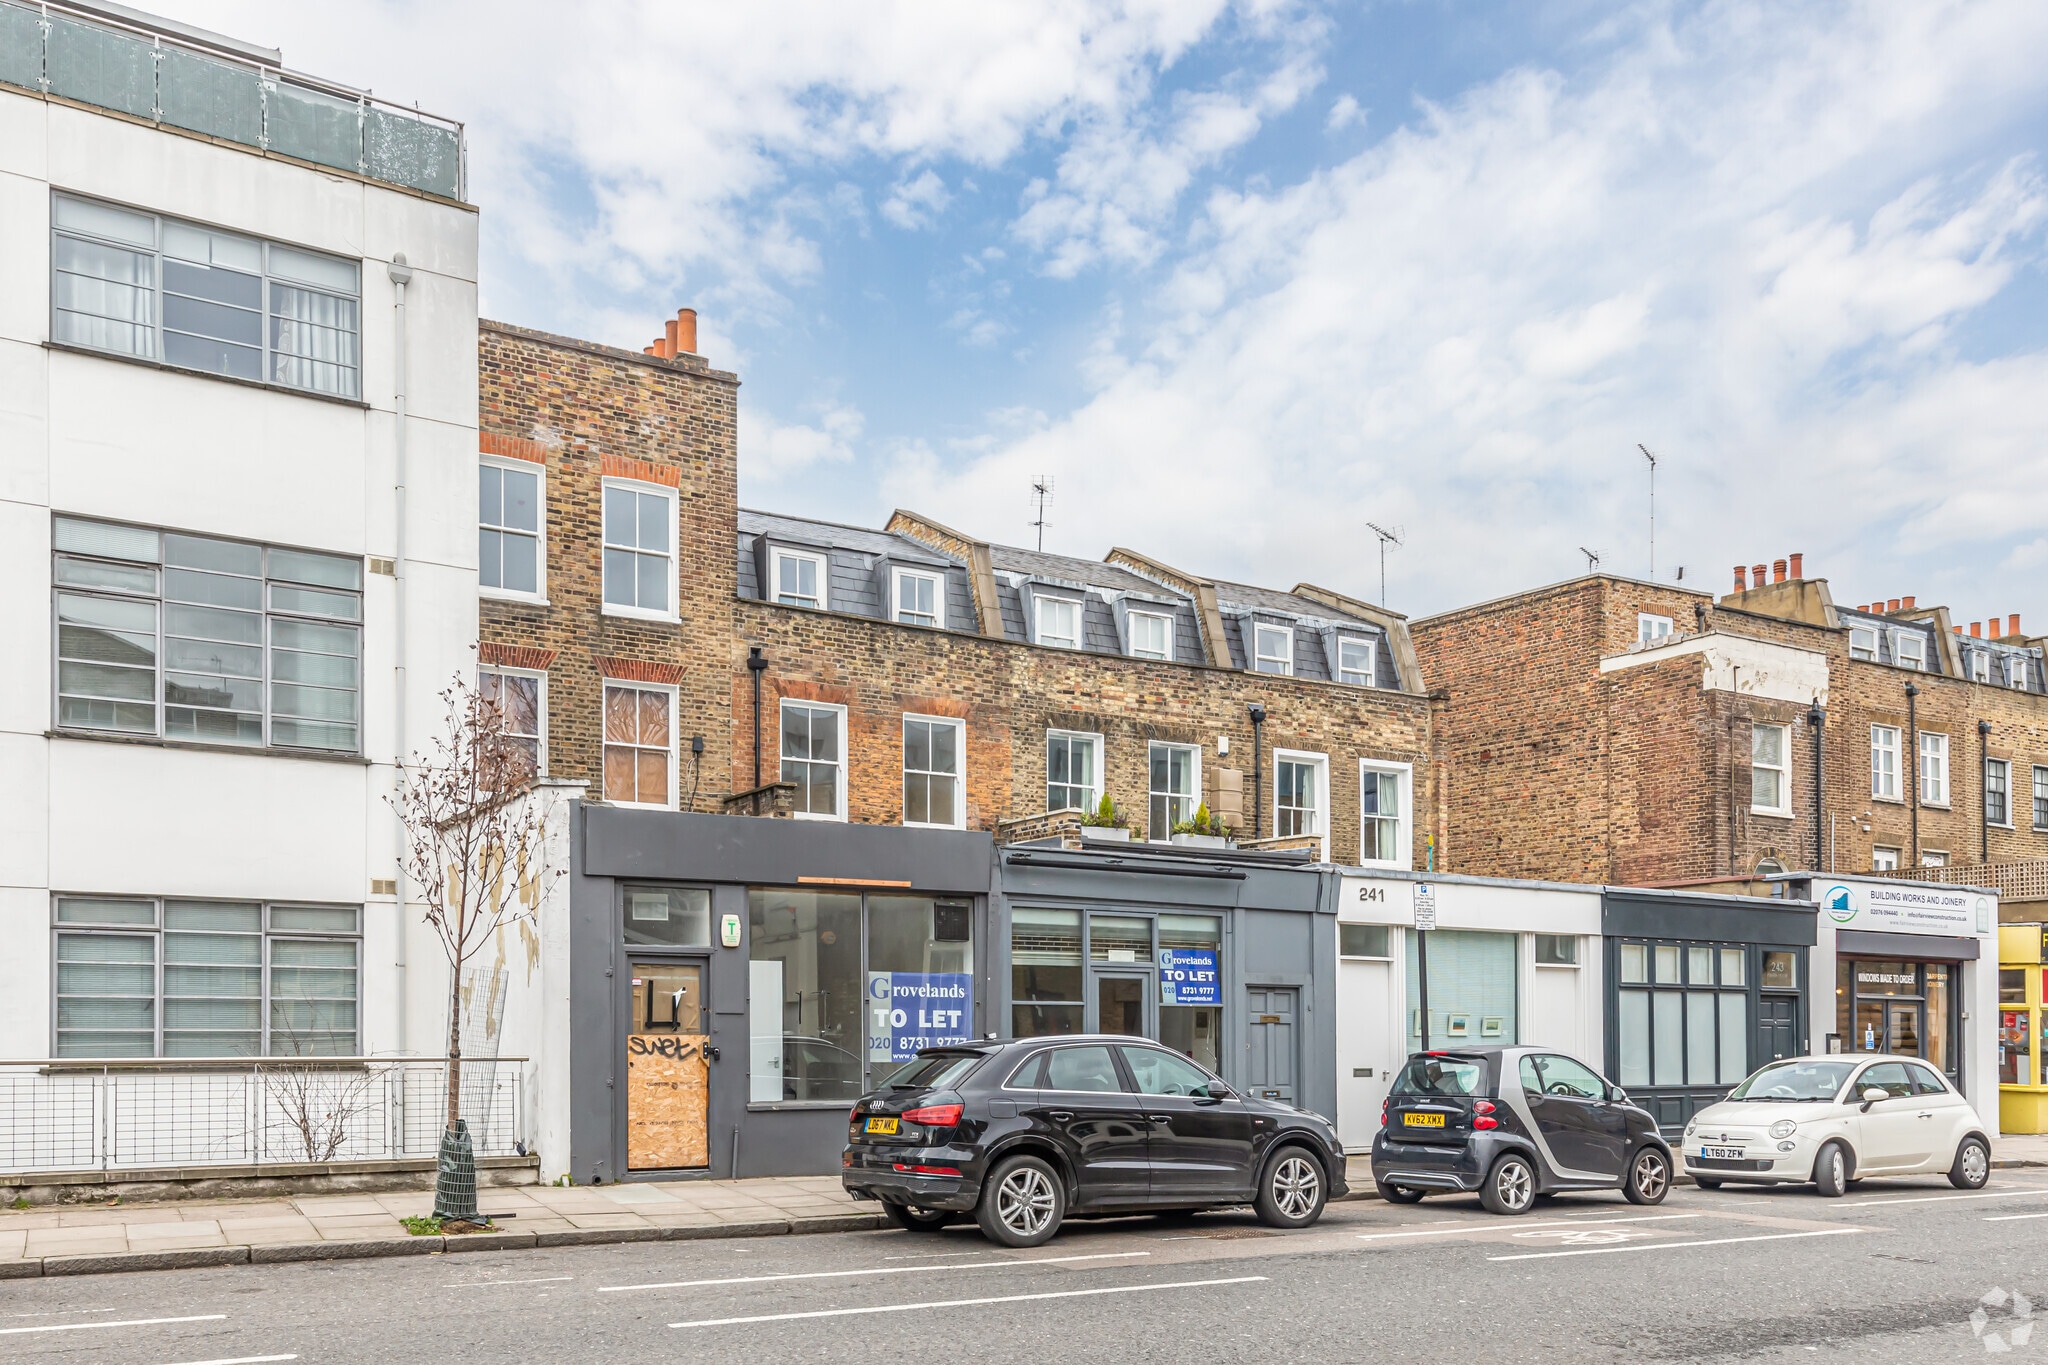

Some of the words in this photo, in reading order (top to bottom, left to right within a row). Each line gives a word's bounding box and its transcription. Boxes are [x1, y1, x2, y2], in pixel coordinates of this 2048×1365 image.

[1360, 887, 1385, 903] 241
[1870, 890, 1901, 901] BUILDING
[1902, 893, 1926, 904] WORKS
[1926, 896, 1940, 905] AND
[1940, 897, 1967, 907] JOINERY
[1162, 952, 1212, 965] Grovelands
[1771, 962, 1785, 972] 243
[1164, 970, 1185, 981] TO
[1189, 971, 1214, 981] LET
[1858, 973, 1880, 983] WINDOWS
[1880, 973, 1893, 984] MADE
[1893, 974, 1899, 984] TO
[1899, 974, 1915, 985] ORDER
[870, 977, 966, 999] Grovelands
[874, 1008, 908, 1028] TO
[918, 1009, 962, 1028] LET
[899, 1037, 929, 1050] 8731
[868, 1118, 884, 1130] LD67
[1406, 1114, 1425, 1125] KV62
[1426, 1115, 1442, 1125] XMX
[1706, 1149, 1725, 1157] LT60
[1728, 1149, 1743, 1158] ZFM
